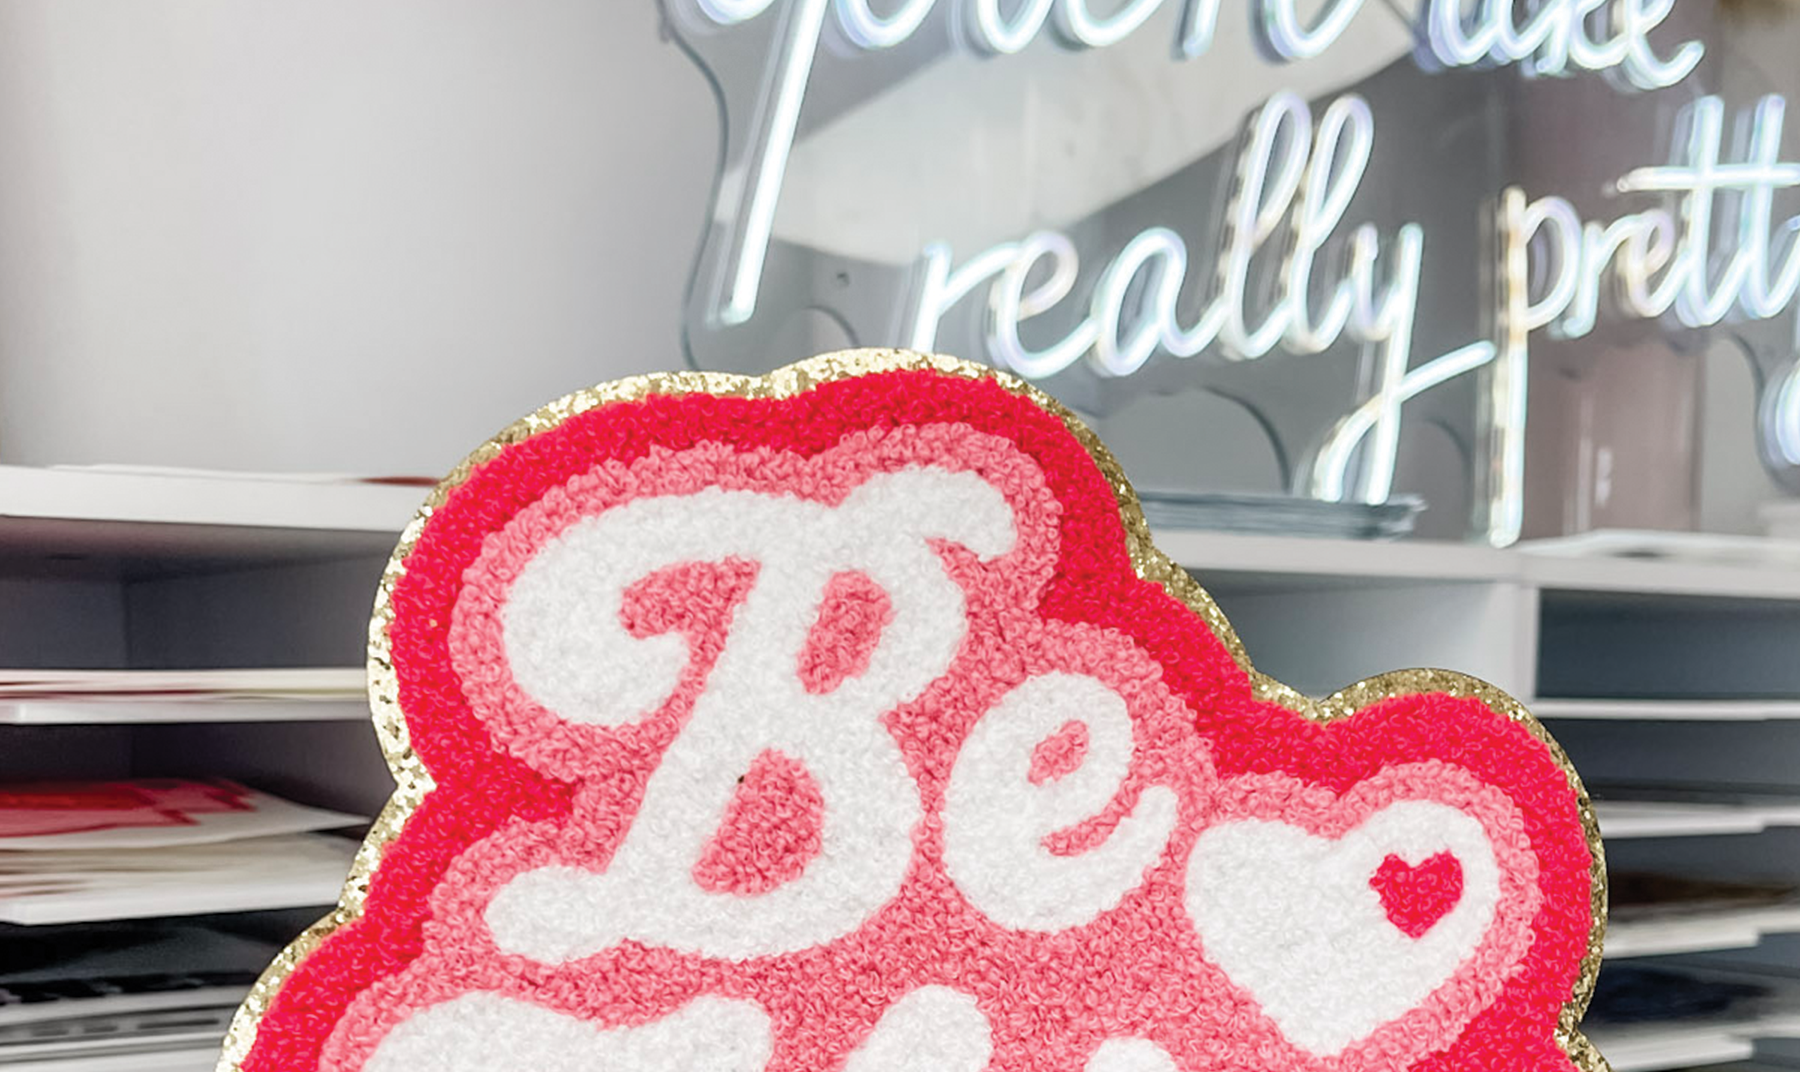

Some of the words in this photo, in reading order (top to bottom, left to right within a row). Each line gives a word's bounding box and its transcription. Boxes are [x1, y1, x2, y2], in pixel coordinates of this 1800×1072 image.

[908, 90, 1496, 504] really
[1488, 93, 1800, 548] prett
[484, 465, 1178, 966] Be
